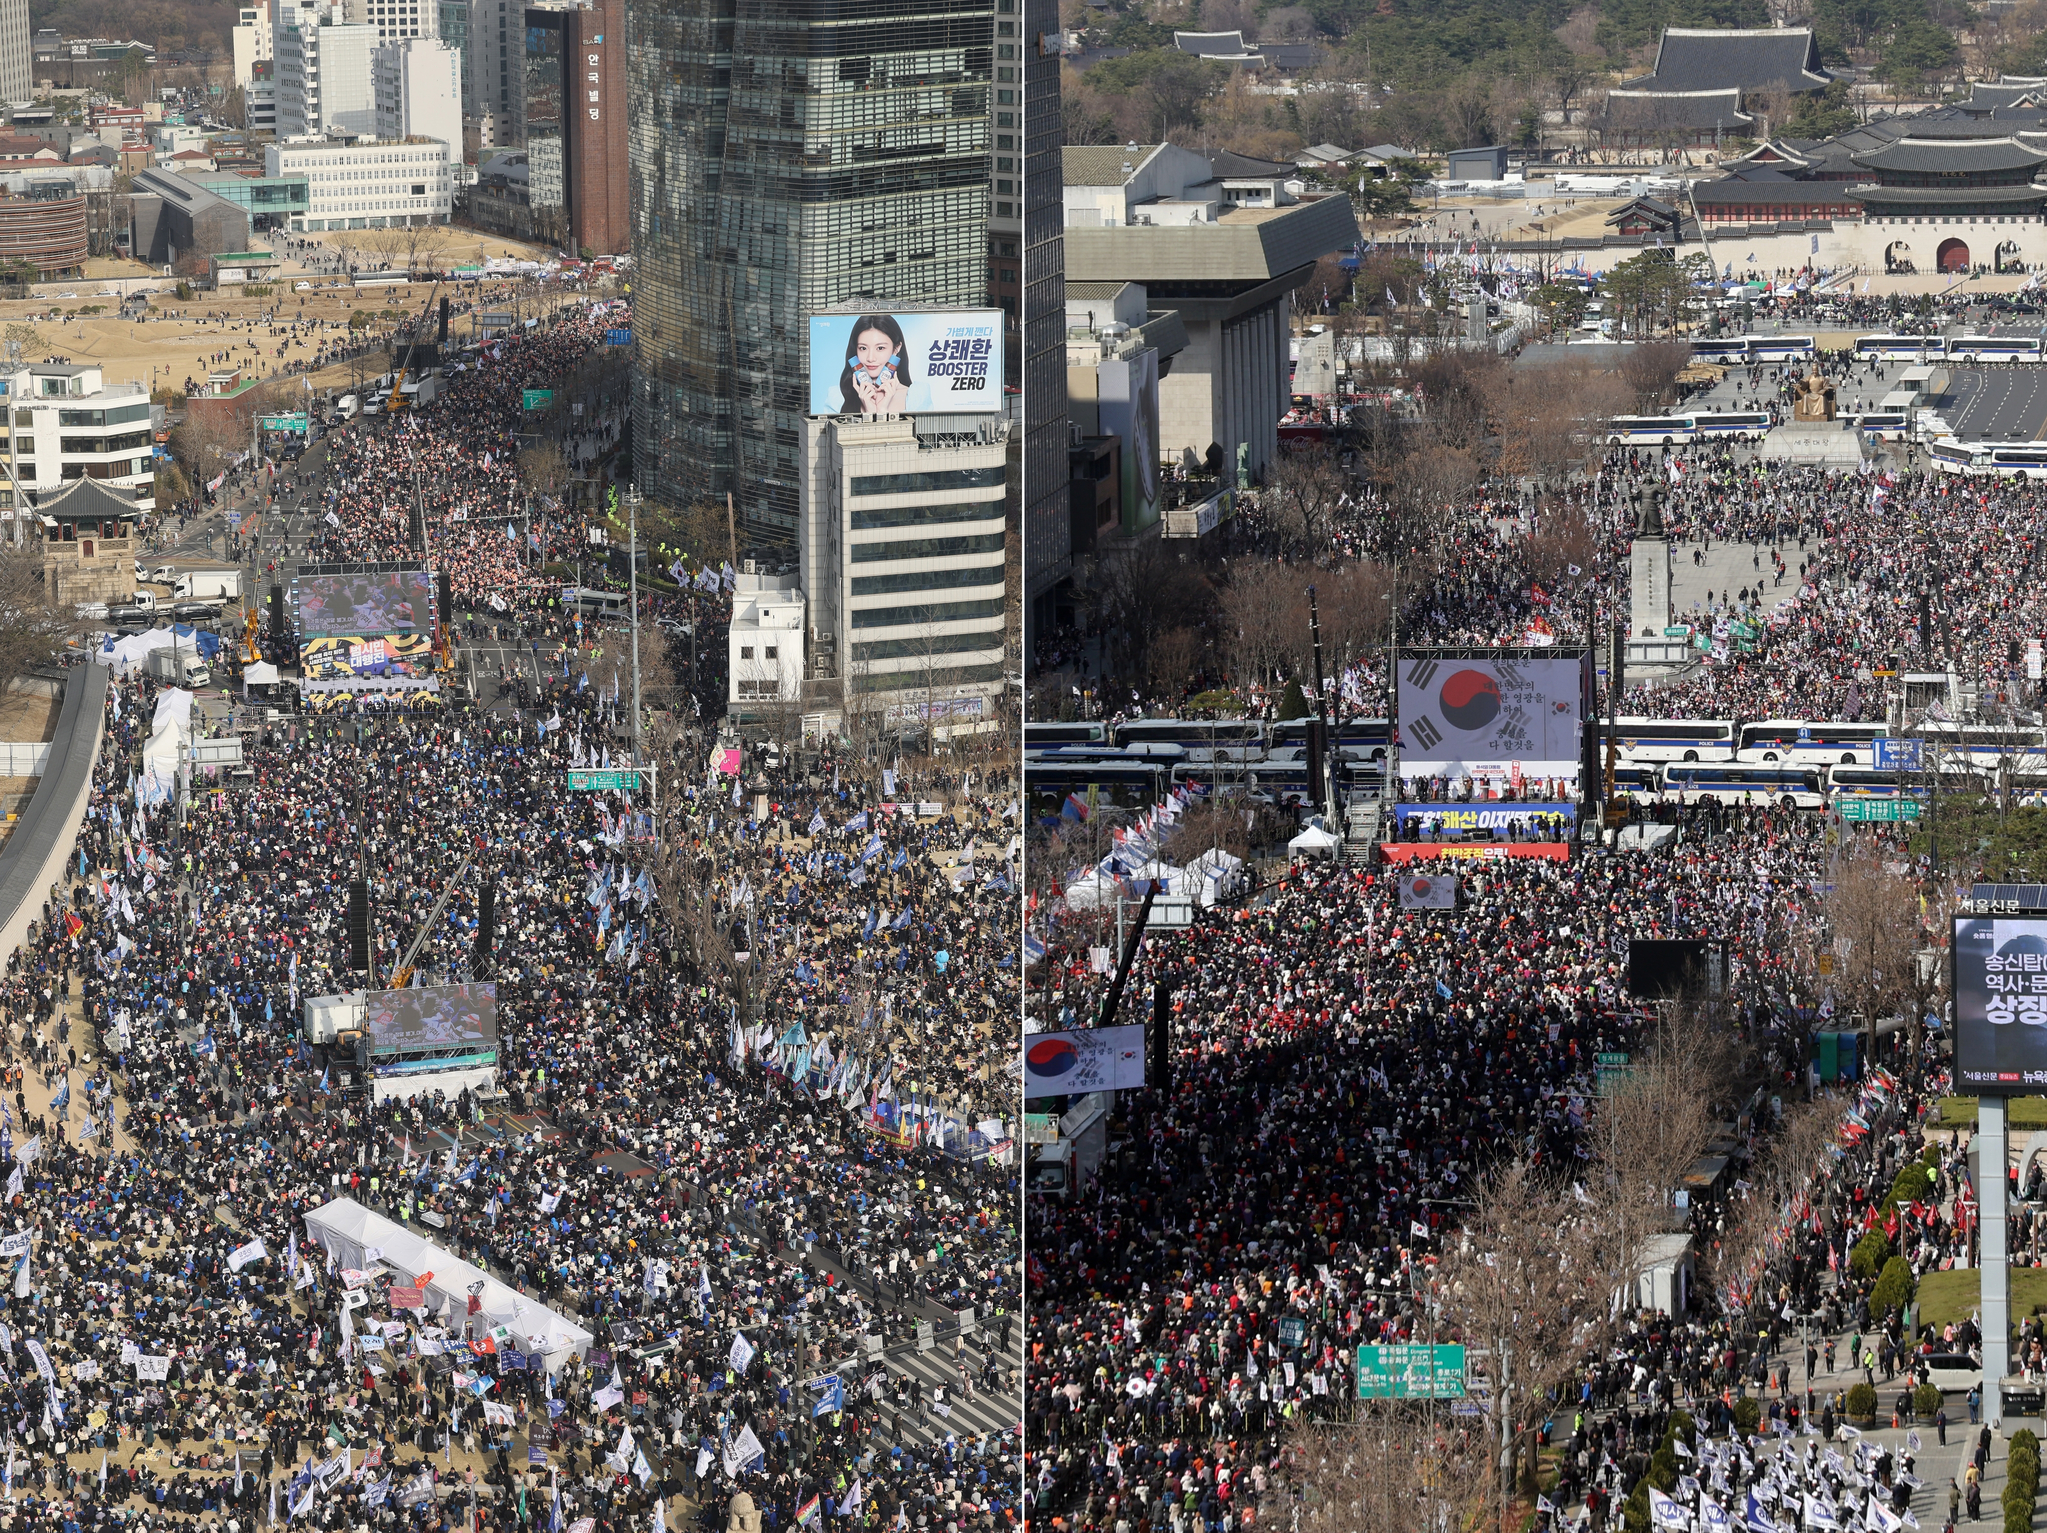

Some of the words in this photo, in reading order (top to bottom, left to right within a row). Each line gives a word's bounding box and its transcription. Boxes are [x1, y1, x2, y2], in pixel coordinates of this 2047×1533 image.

[588, 53, 599, 120] 안국빌딩
[946, 327, 973, 337] 가볍게
[974, 326, 993, 337] 깬다
[928, 338, 993, 361] 상쾌환
[927, 362, 988, 377] BOOSTER
[951, 376, 986, 391] ZERO
[1794, 438, 1829, 446] 세종대왕
[333, 648, 344, 656] 퇴진!
[349, 640, 385, 657] 범시민
[350, 652, 385, 668] 대행진
[1483, 681, 1534, 692] 대한민국의
[1513, 692, 1544, 704] 영광을
[1489, 740, 1499, 751] 다
[1503, 740, 1534, 751] 할것을
[1960, 898, 2020, 914] 서울신문
[1089, 1047, 1113, 1057] 영광을
[1964, 1071, 1997, 1080] 서울신문
[1068, 1080, 1076, 1088] 다
[1657, 1504, 1680, 1518] 해사
